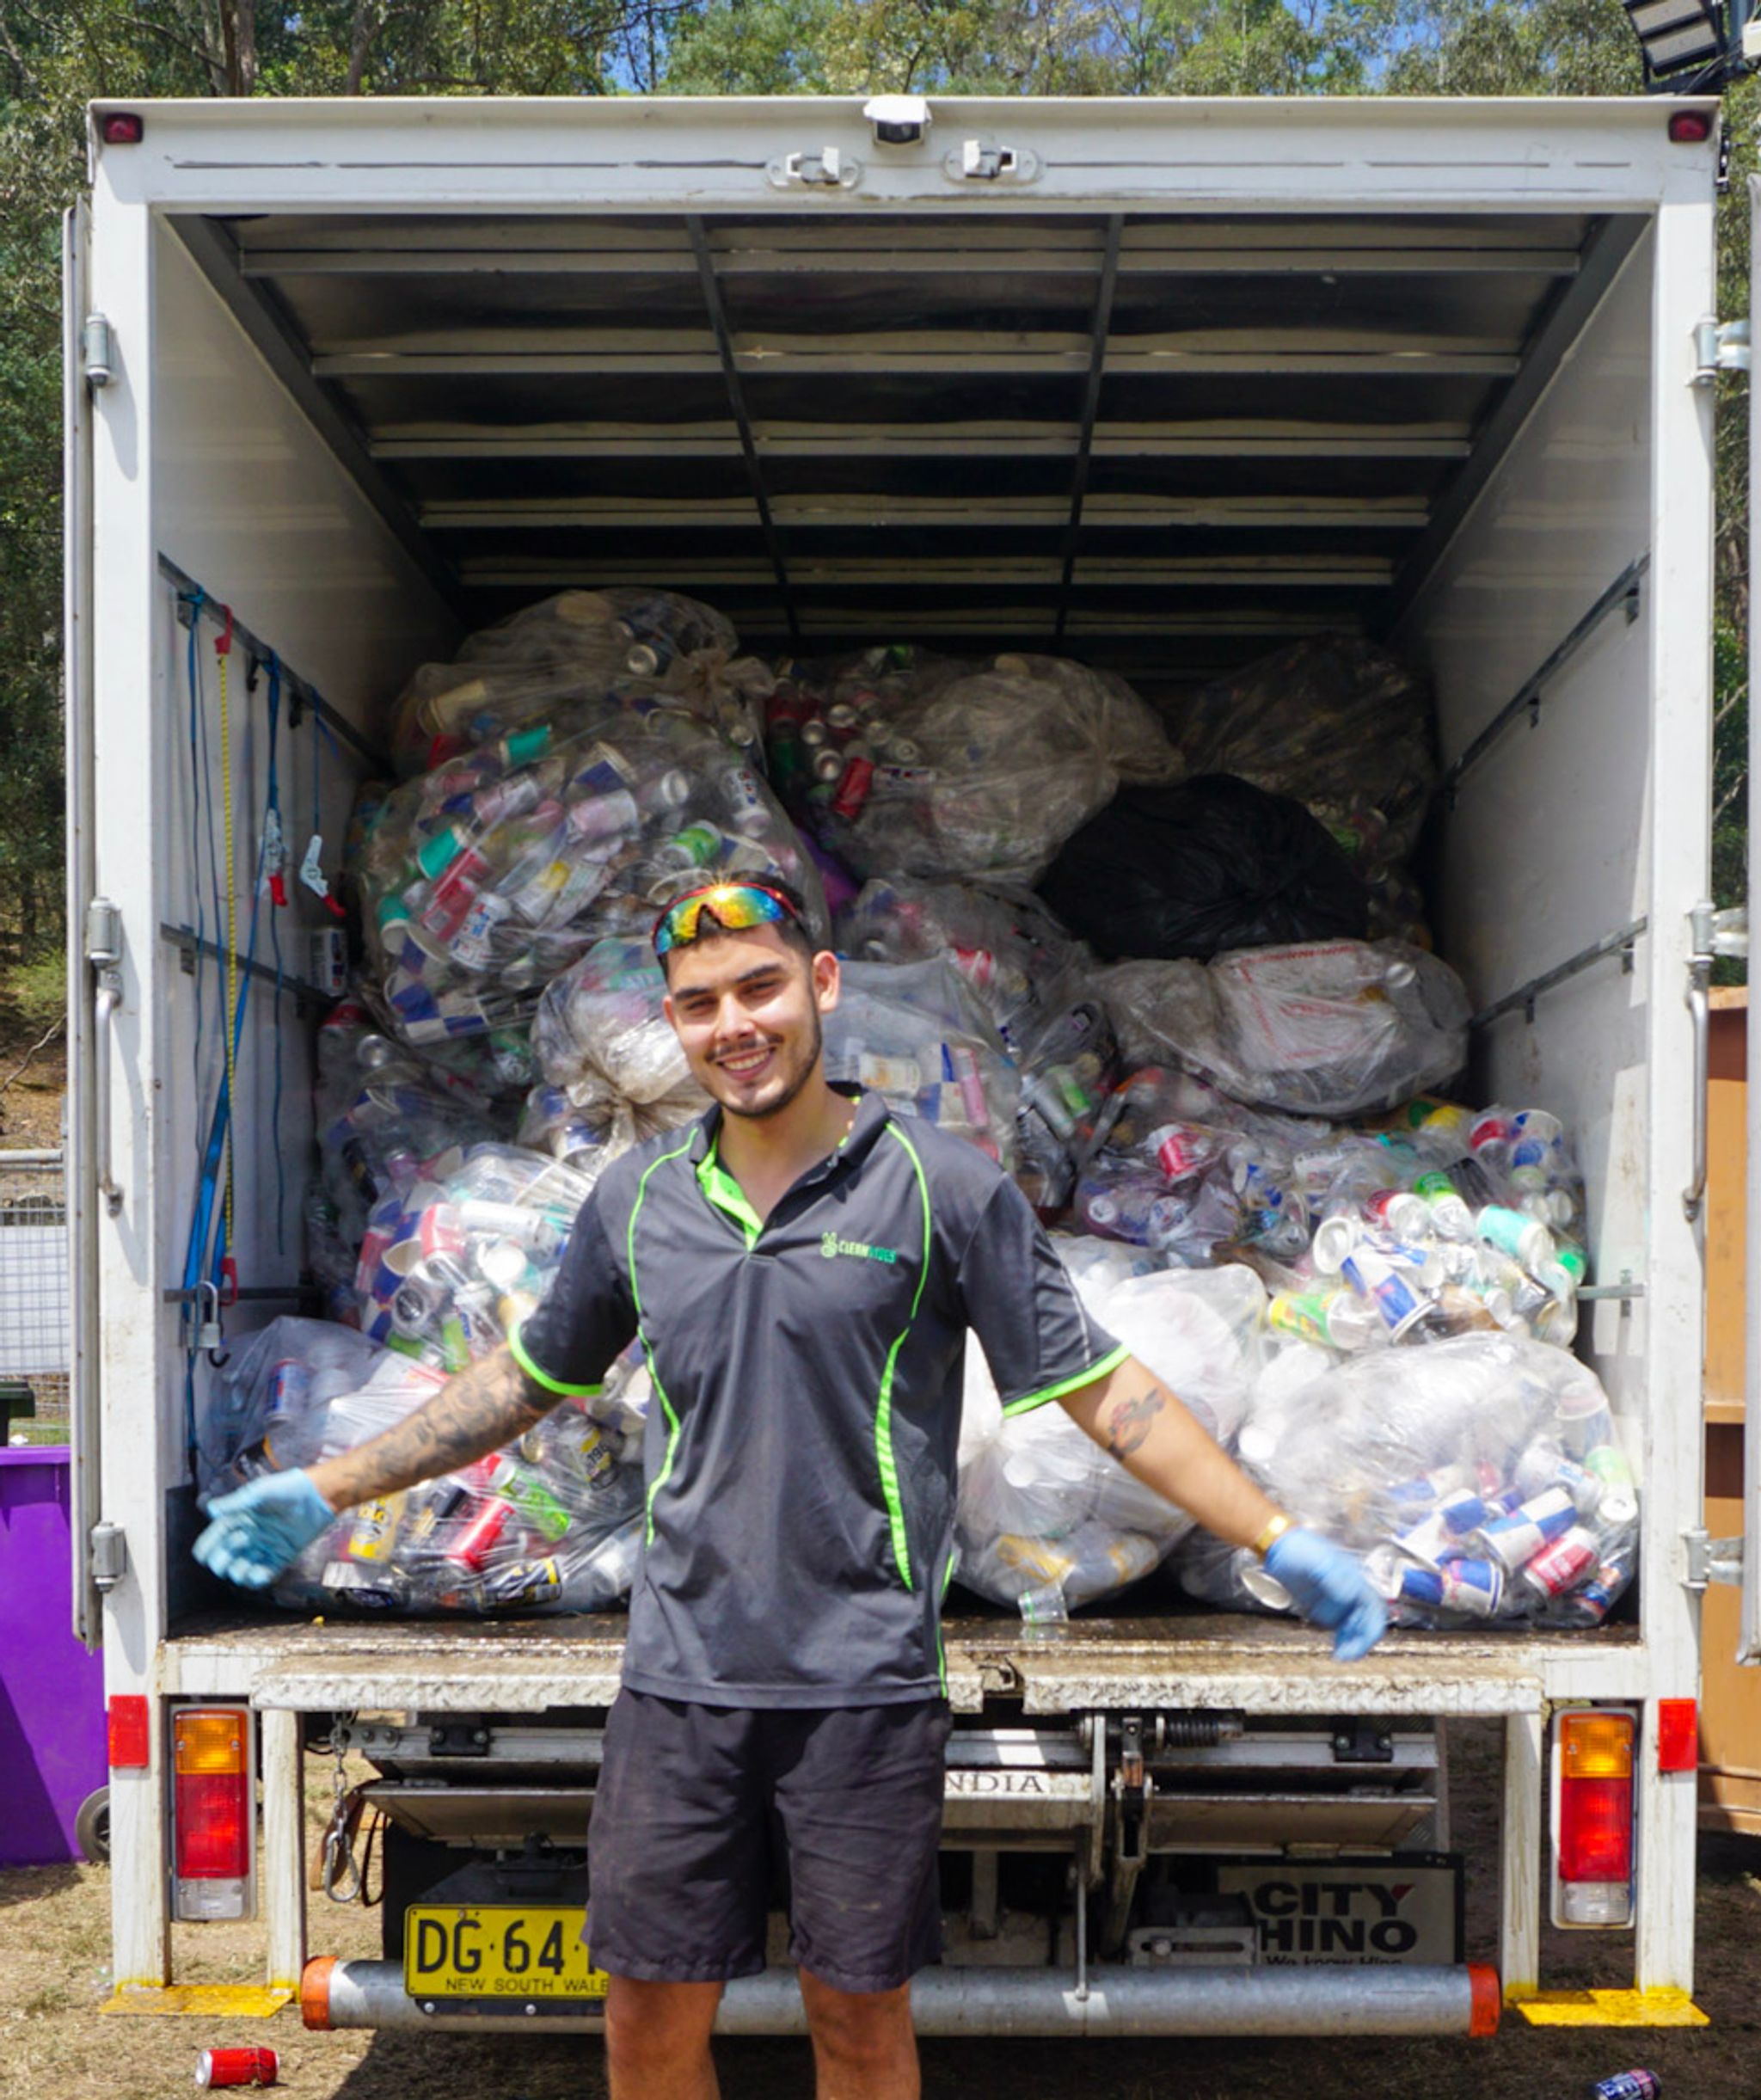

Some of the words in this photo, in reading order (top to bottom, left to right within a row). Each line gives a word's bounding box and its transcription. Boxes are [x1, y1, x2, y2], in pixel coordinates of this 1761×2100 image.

[944, 1773, 1044, 1793] NDIA
[1255, 1882, 1414, 1916] CITY
[1258, 1919, 1417, 1953] HINO
[445, 1978, 484, 1992] NEW
[494, 1978, 553, 1992] SOUTH
[564, 1978, 608, 1992] WALE
